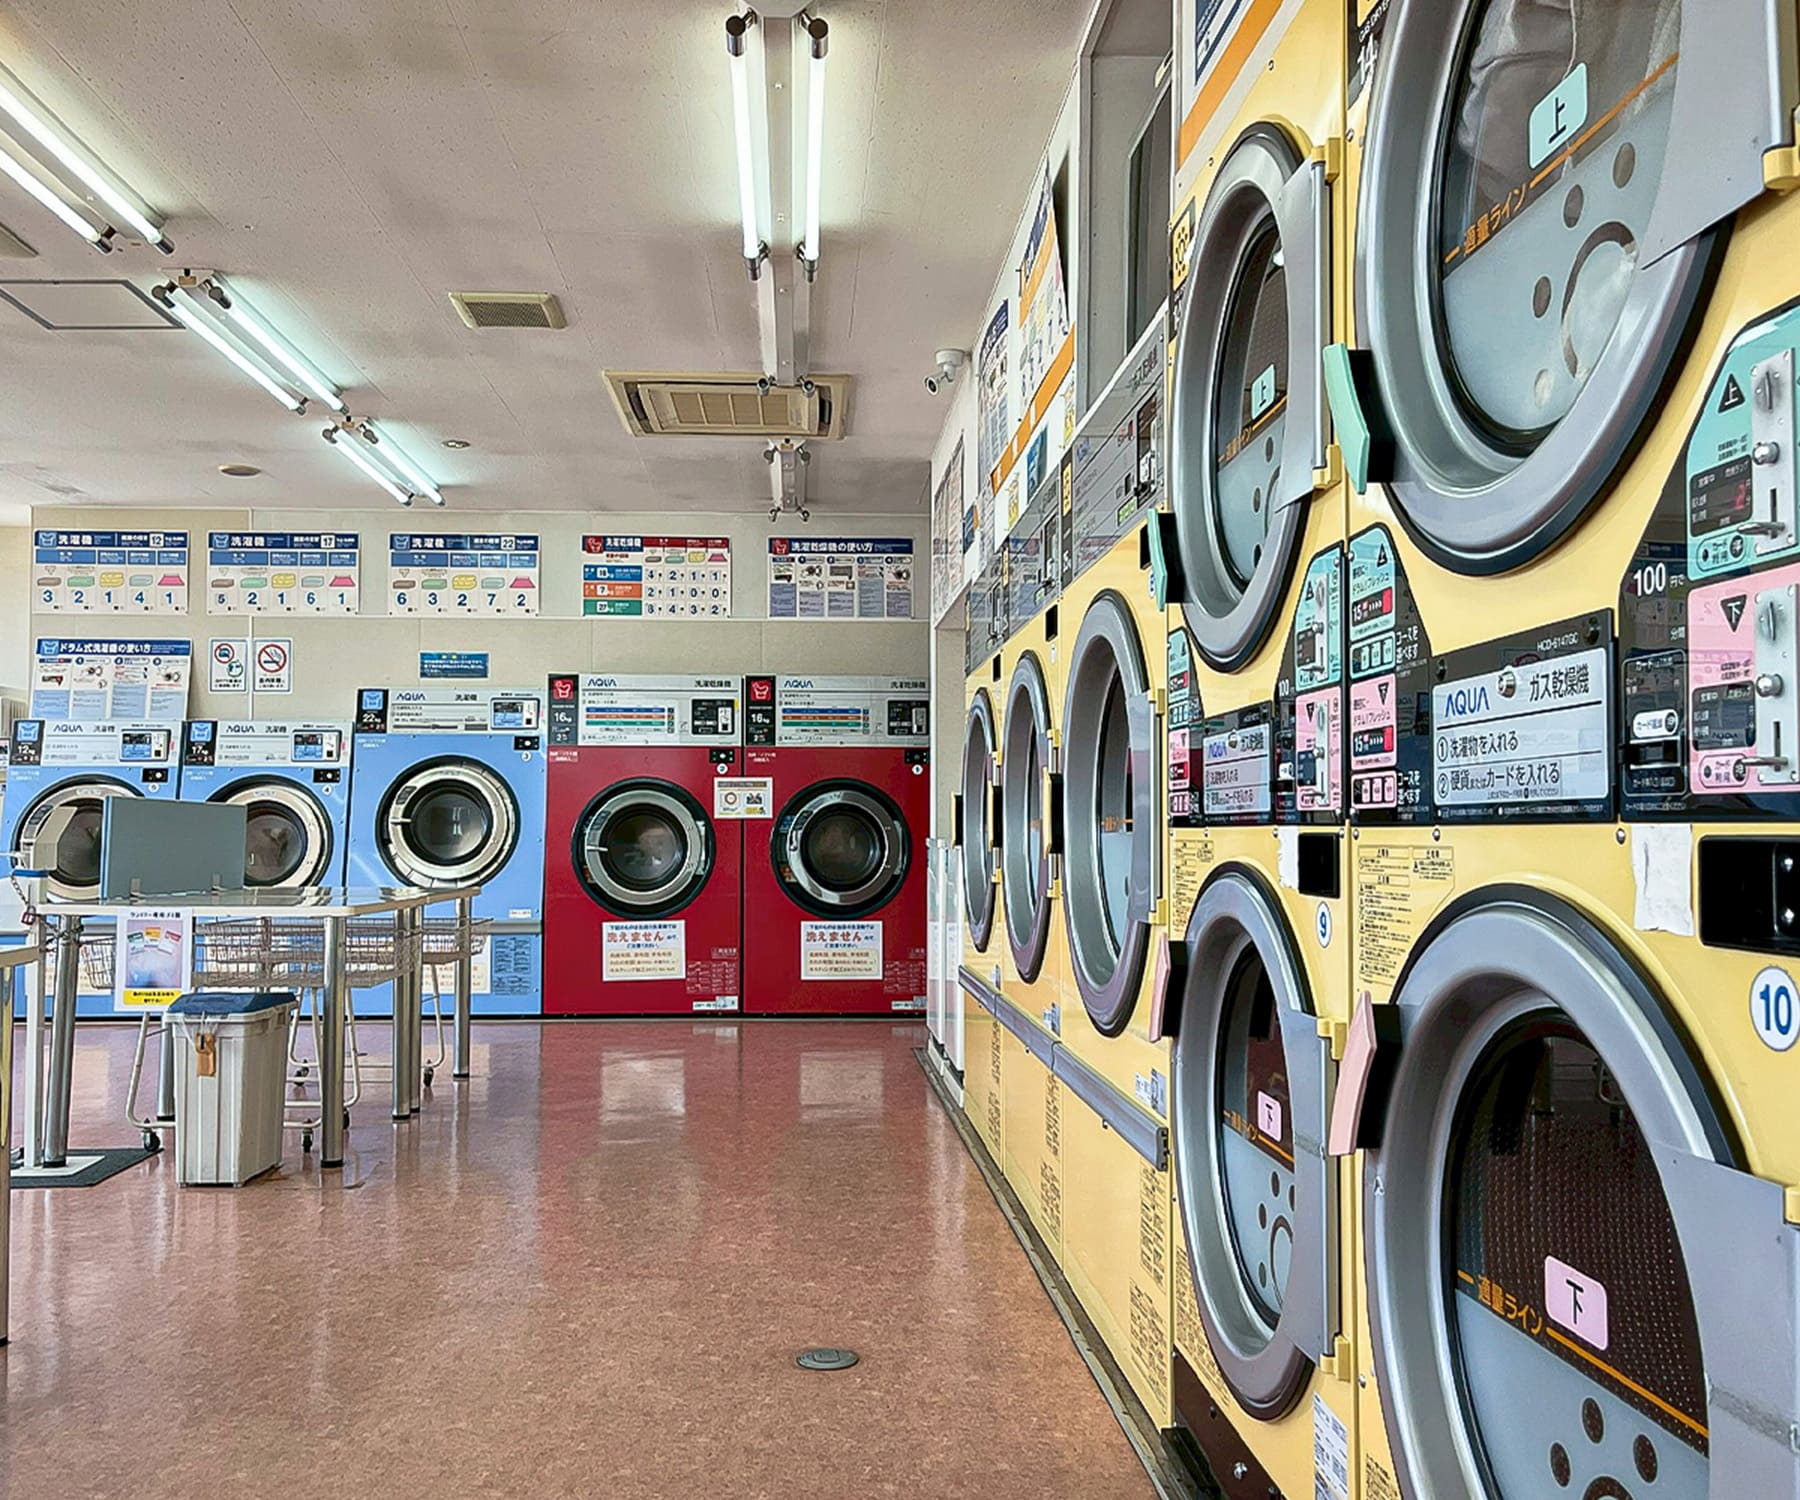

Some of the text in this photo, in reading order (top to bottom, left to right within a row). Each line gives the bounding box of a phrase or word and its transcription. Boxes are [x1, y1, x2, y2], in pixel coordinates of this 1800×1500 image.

[1548, 97, 1567, 145] 上
[1724, 383, 1739, 405] 上
[1633, 562, 1666, 597] 100
[43, 590, 53, 603] 3
[74, 590, 84, 603] 2
[135, 592, 144, 603] 4
[248, 592, 257, 605] 2
[307, 592, 316, 604] 6
[397, 592, 526, 606] 6 3 2 7 2
[1727, 600, 1742, 624] 下
[588, 678, 617, 687] AQUA
[783, 680, 813, 688] AQUA
[1529, 664, 1589, 702] ガス乾燥機
[397, 692, 426, 701] AQUA
[1445, 687, 1489, 717] AQUA
[53, 724, 83, 732] AQUA
[226, 724, 256, 733] AQUA
[1450, 731, 1518, 758] 洗濯物を入れる
[1320, 911, 1327, 938] 9
[1759, 984, 1792, 1036] 10
[1566, 1279, 1584, 1325] 下
